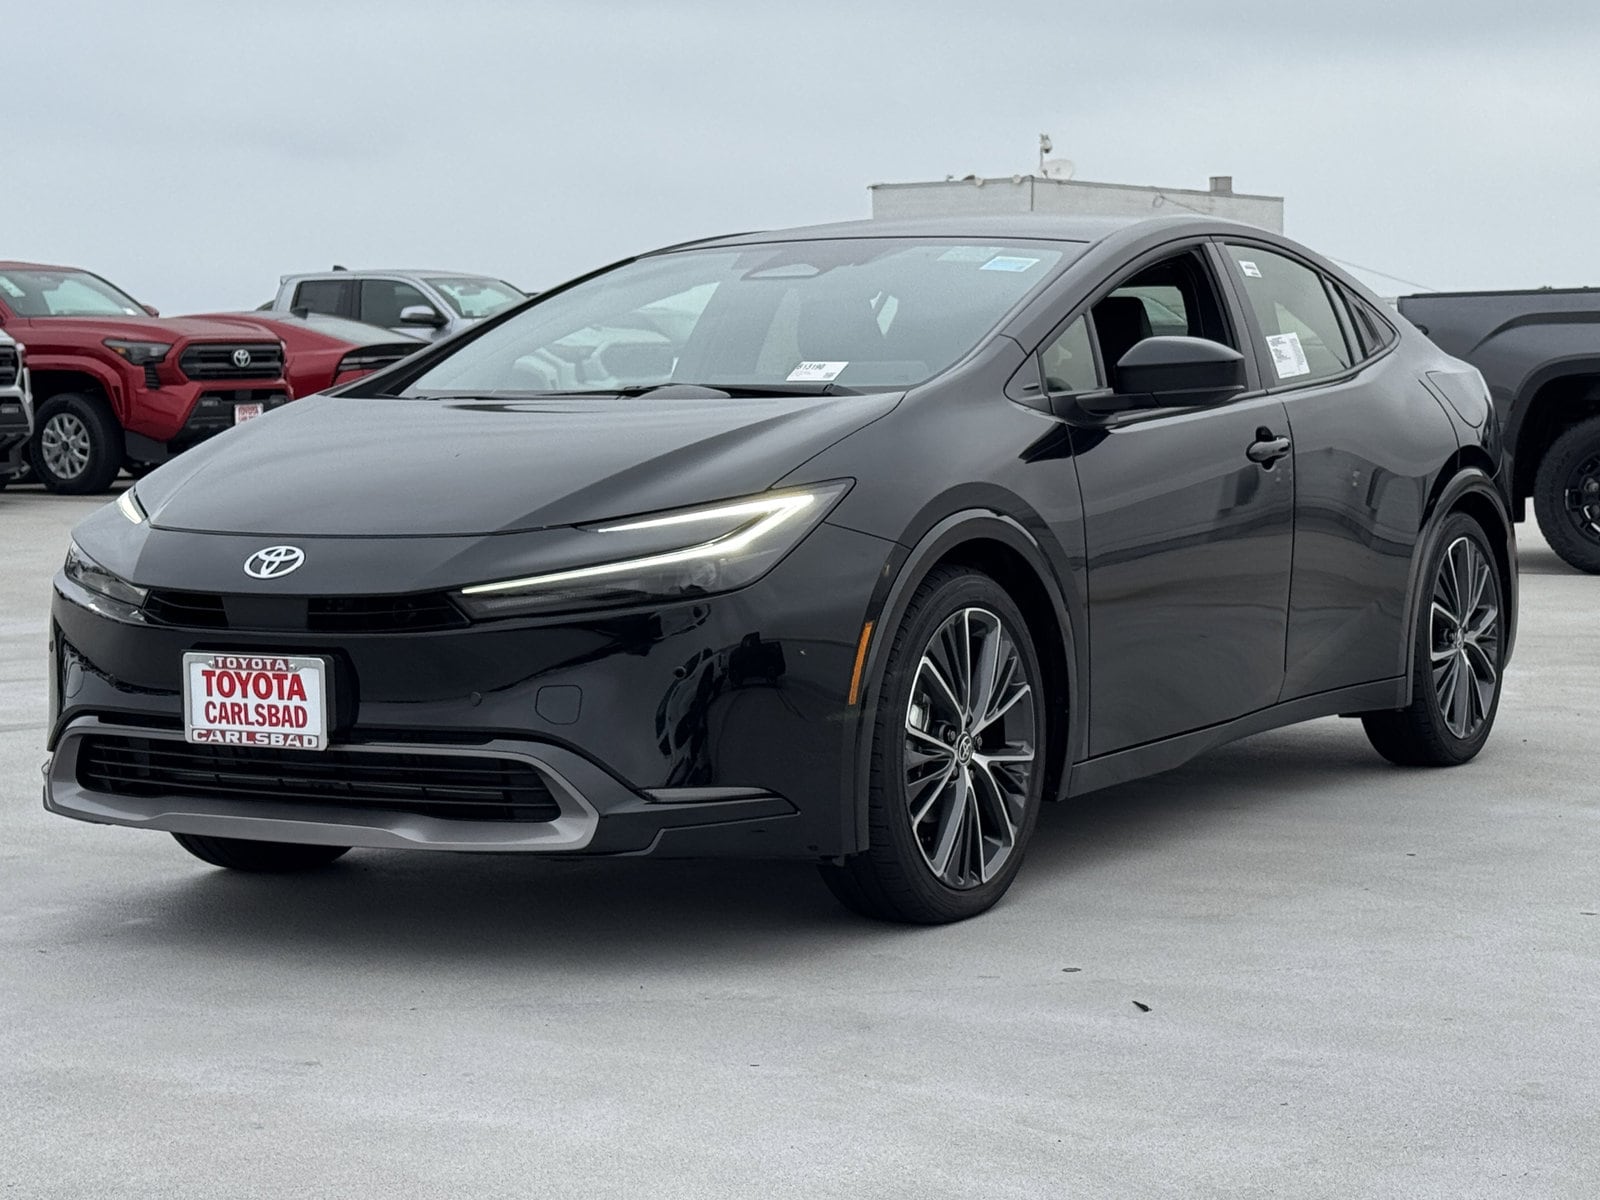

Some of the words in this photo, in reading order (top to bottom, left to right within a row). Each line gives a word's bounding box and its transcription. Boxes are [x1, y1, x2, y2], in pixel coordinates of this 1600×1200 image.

[215, 656, 287, 671] TOYOTA
[202, 670, 307, 701] TOYOTA
[205, 701, 308, 728] CARLSBAD
[192, 729, 318, 748] CARLSBAD
